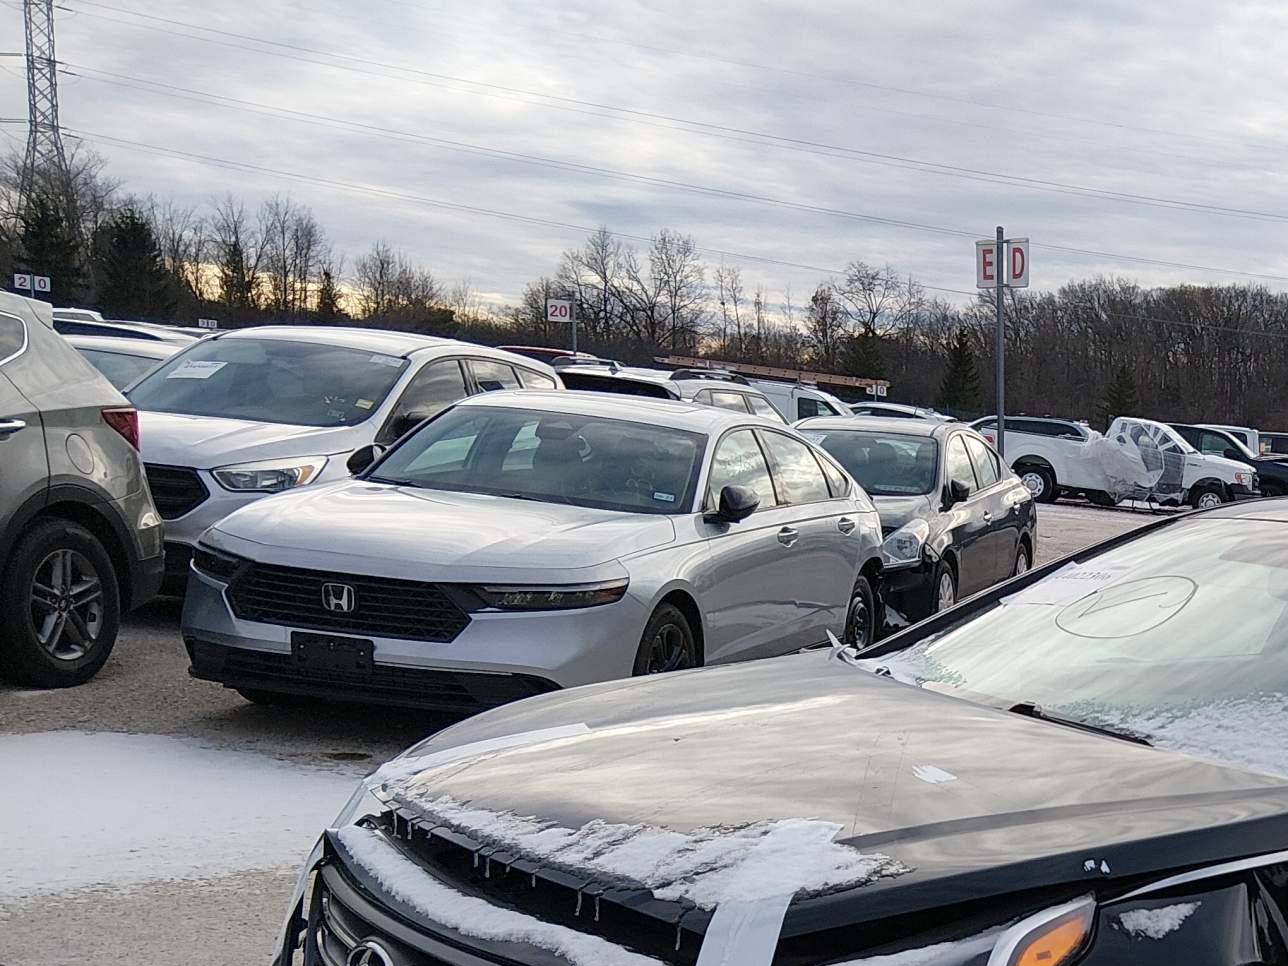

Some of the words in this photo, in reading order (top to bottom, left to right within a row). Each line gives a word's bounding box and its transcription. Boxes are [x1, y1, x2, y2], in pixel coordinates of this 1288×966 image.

[983, 248, 994, 280] E
[1012, 247, 1025, 279] D
[550, 304, 568, 318] 20
